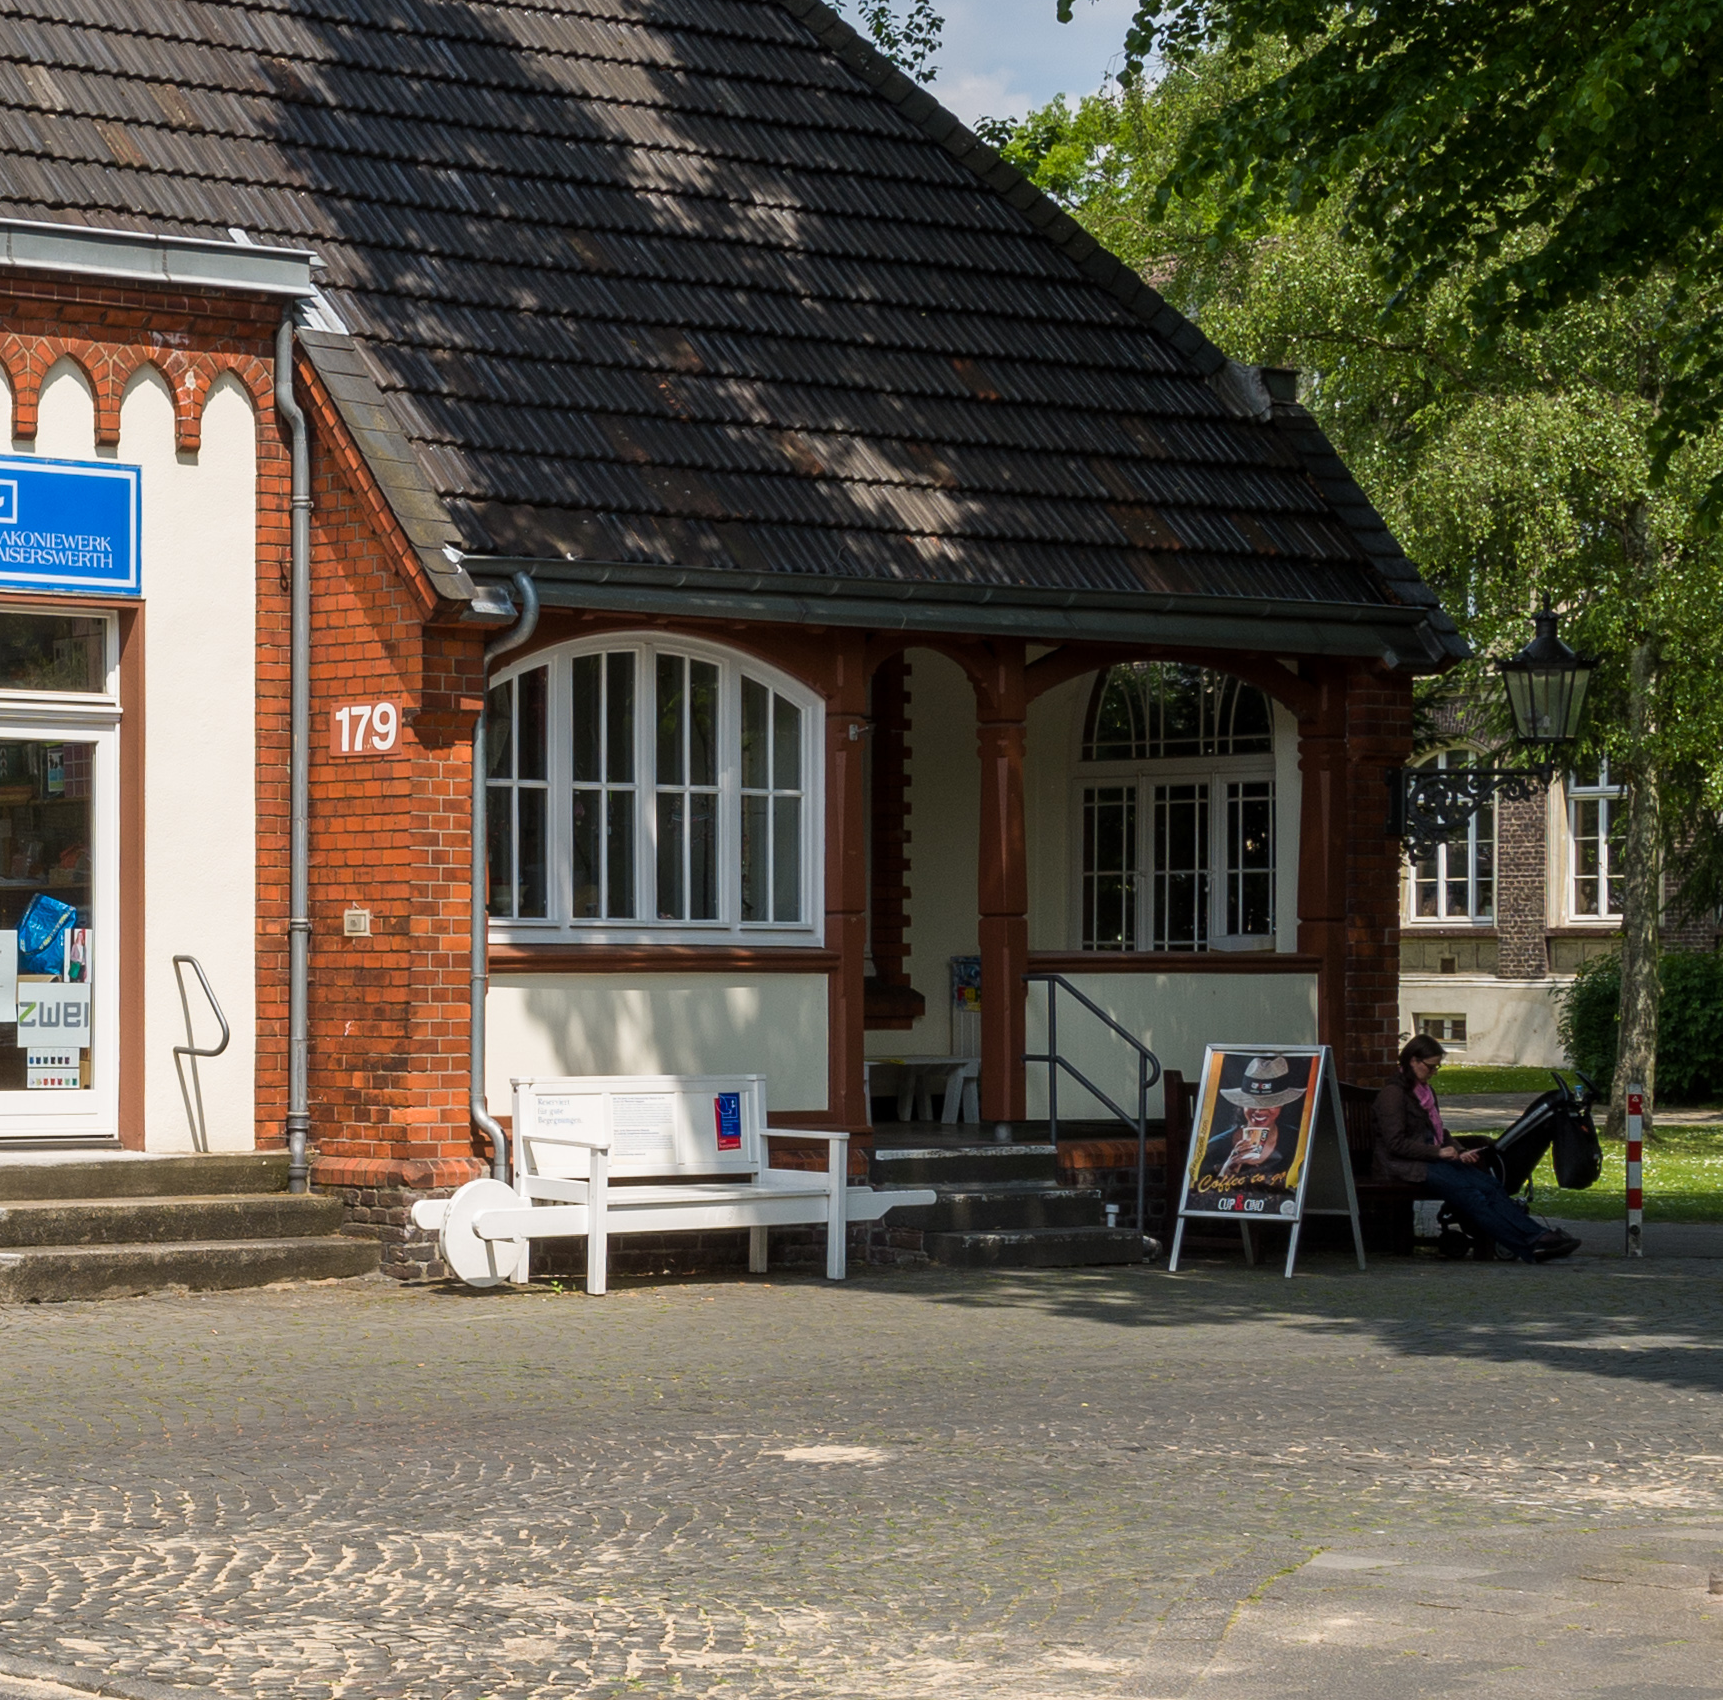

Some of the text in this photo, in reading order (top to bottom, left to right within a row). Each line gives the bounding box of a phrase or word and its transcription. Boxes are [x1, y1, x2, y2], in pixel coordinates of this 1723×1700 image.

[335, 702, 397, 752] 179
[1198, 1174, 1246, 1193] Coffee
[1250, 1173, 1265, 1184] to
[1218, 1197, 1236, 1210] CUP
